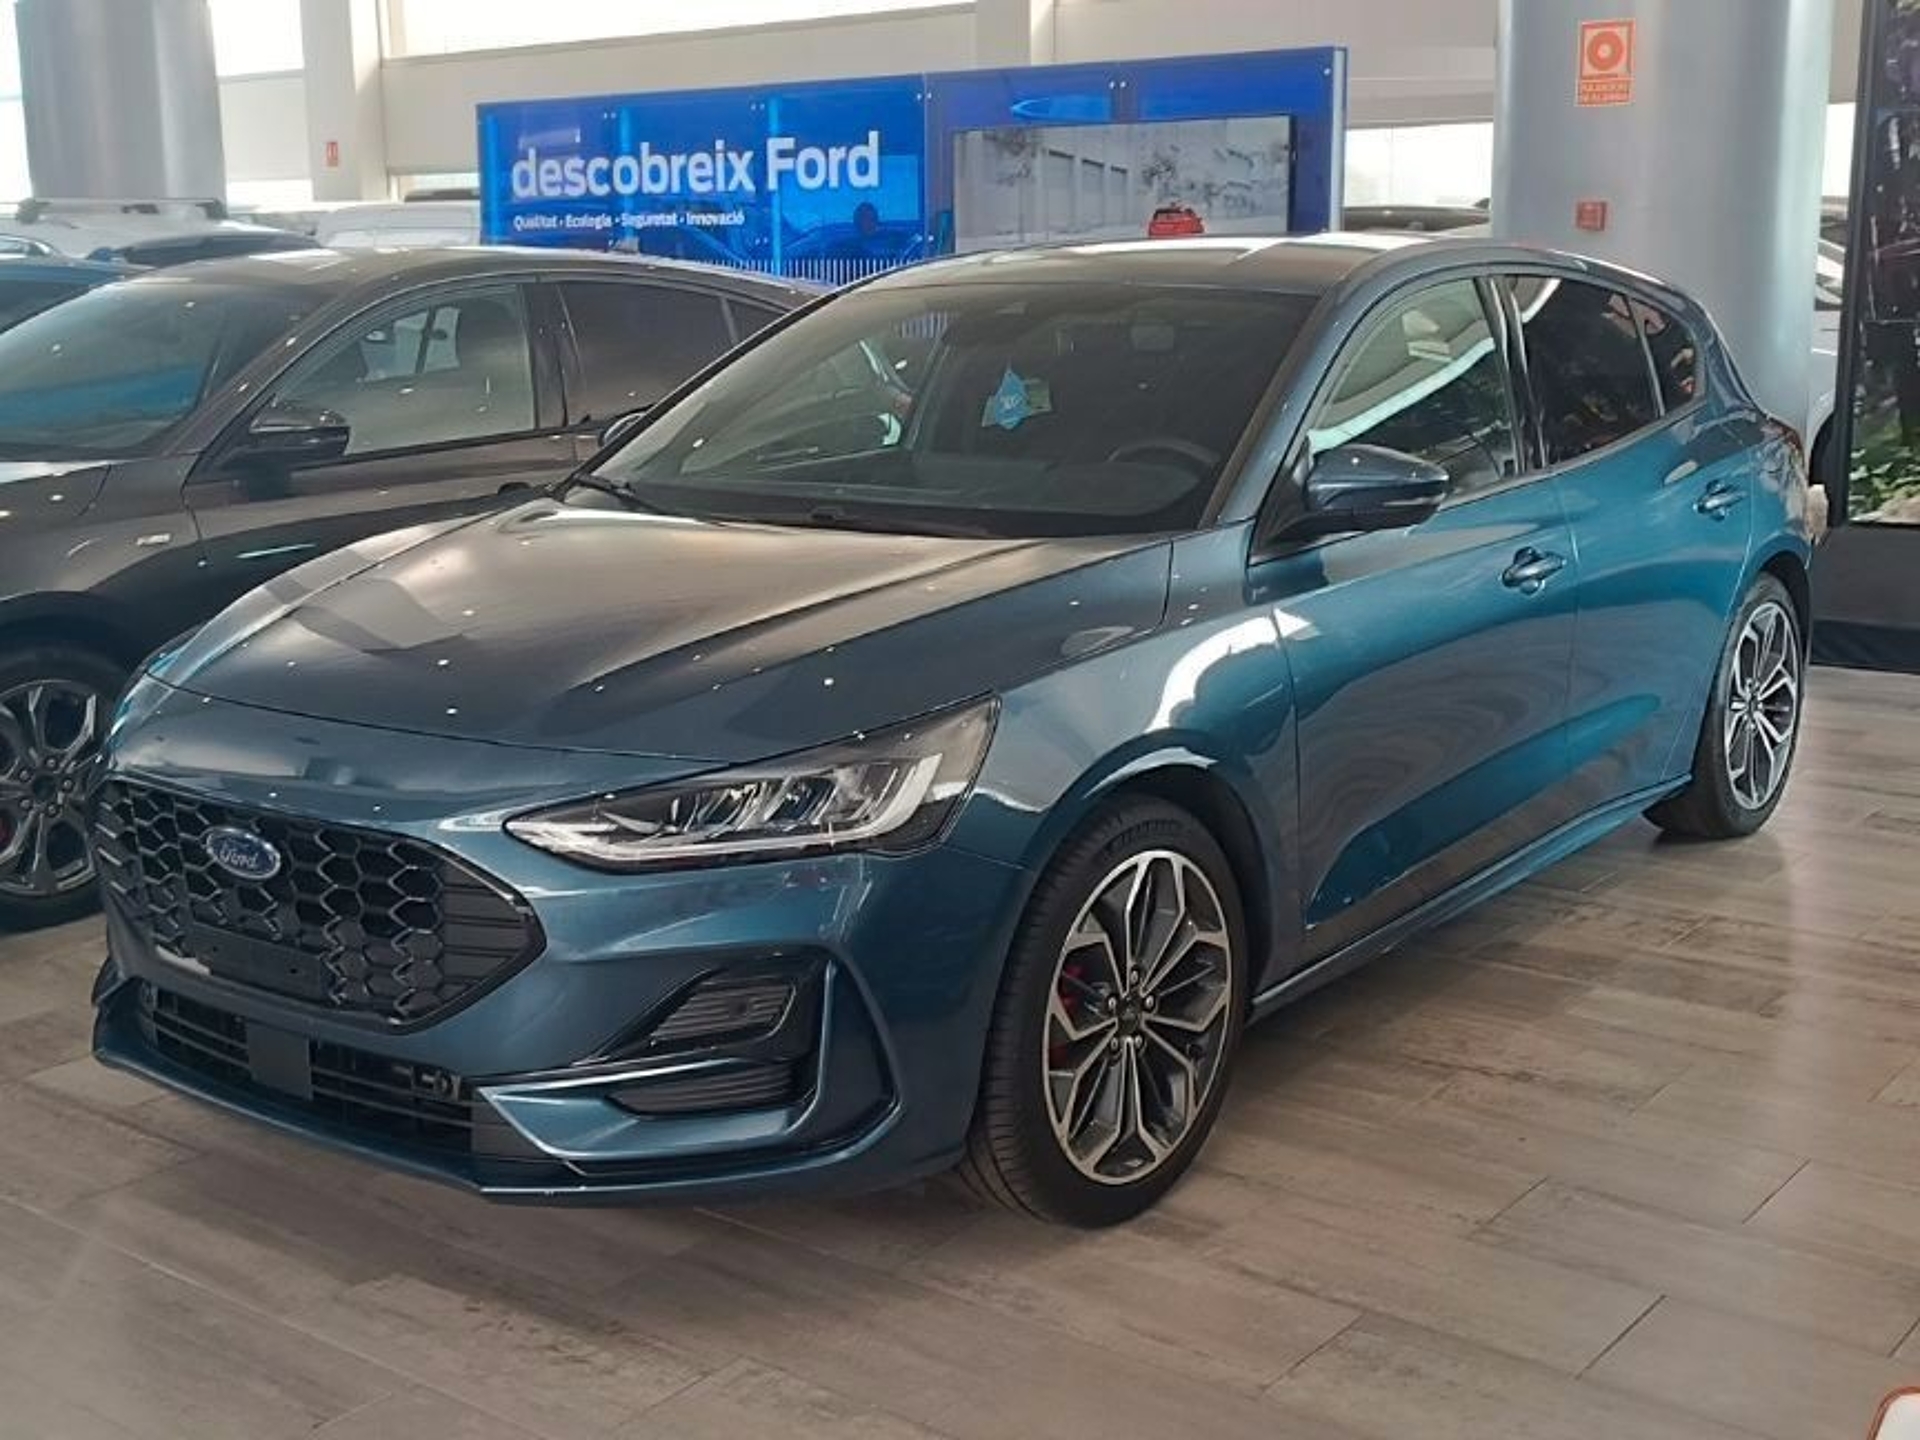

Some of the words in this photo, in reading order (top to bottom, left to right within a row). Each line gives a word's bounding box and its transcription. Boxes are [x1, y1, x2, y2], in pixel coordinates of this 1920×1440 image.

[511, 139, 756, 198] descobreix
[766, 130, 880, 190] Ford
[565, 213, 612, 230] Ecologia
[219, 838, 259, 870] Ford
